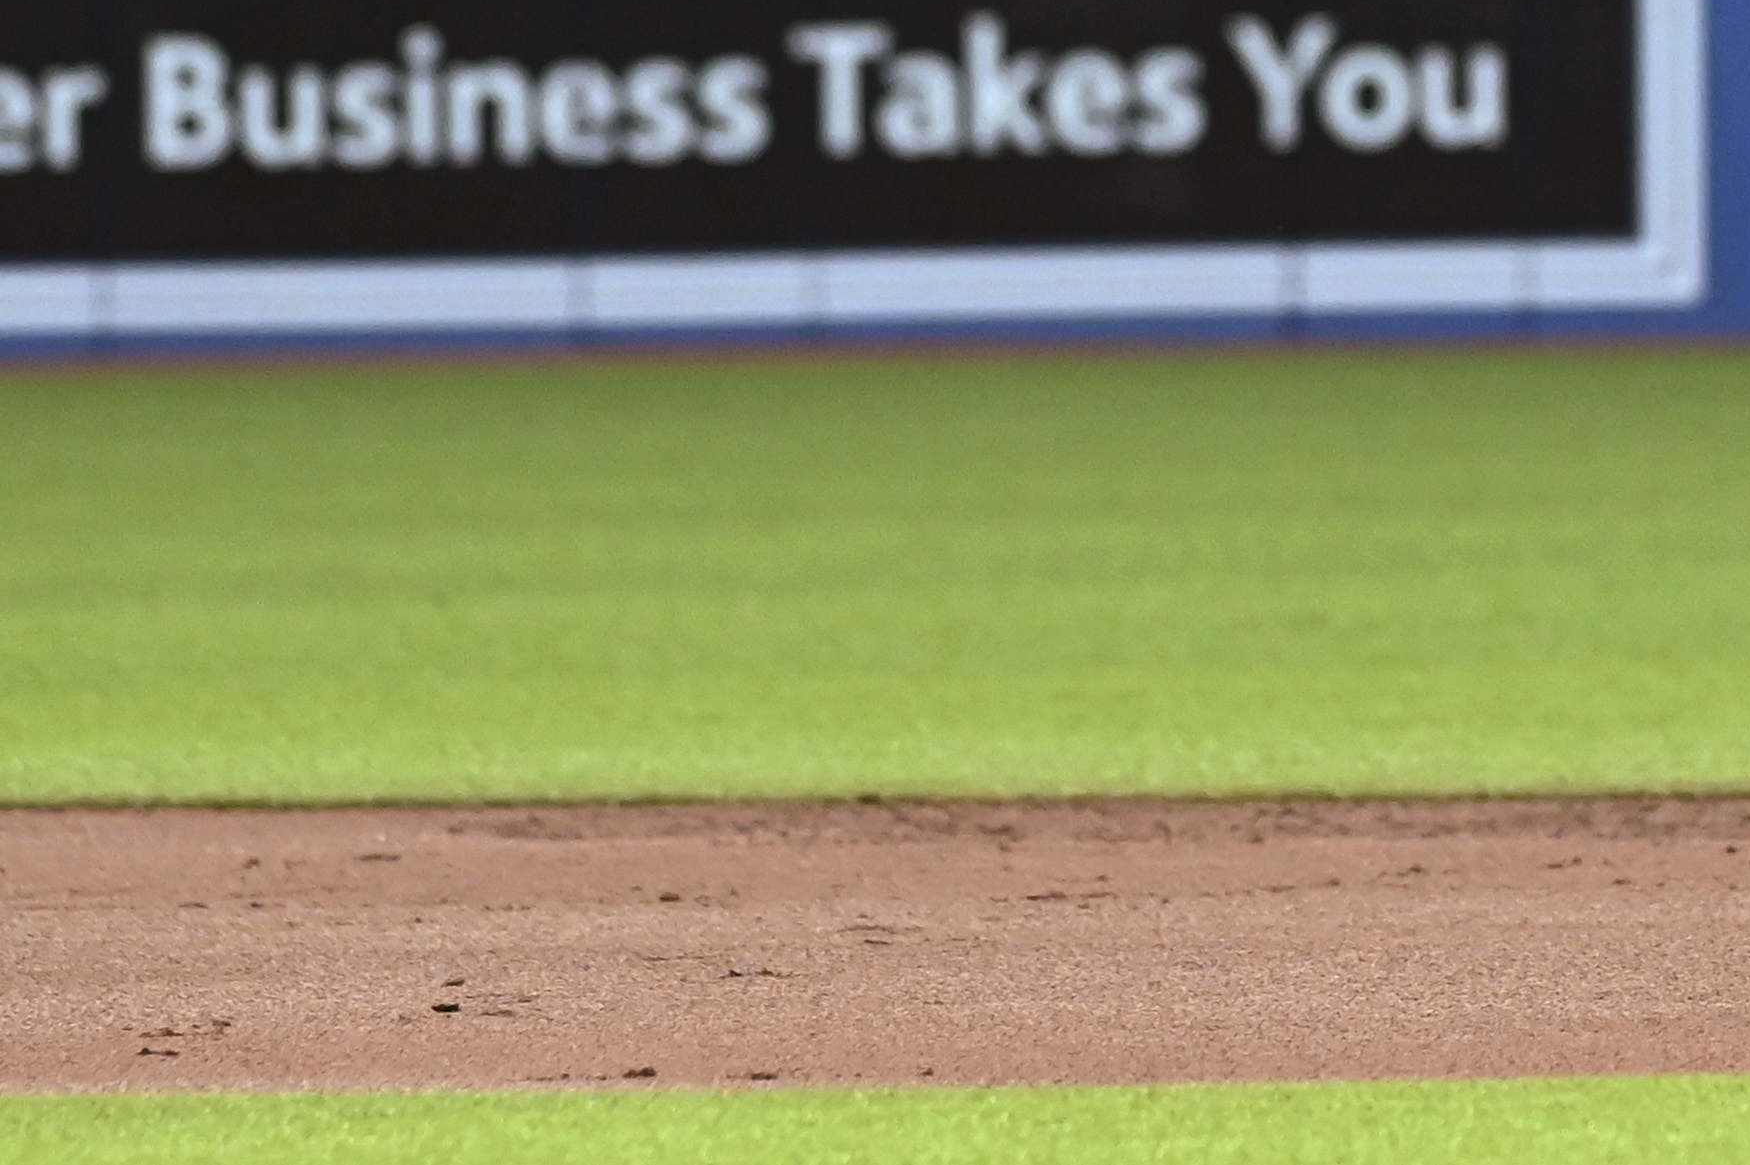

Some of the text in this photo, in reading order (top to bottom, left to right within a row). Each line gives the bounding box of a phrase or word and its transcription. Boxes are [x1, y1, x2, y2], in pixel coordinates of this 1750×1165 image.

[143, 24, 770, 171] Business
[790, 14, 1206, 158] Takes
[1226, 12, 1508, 152] You
